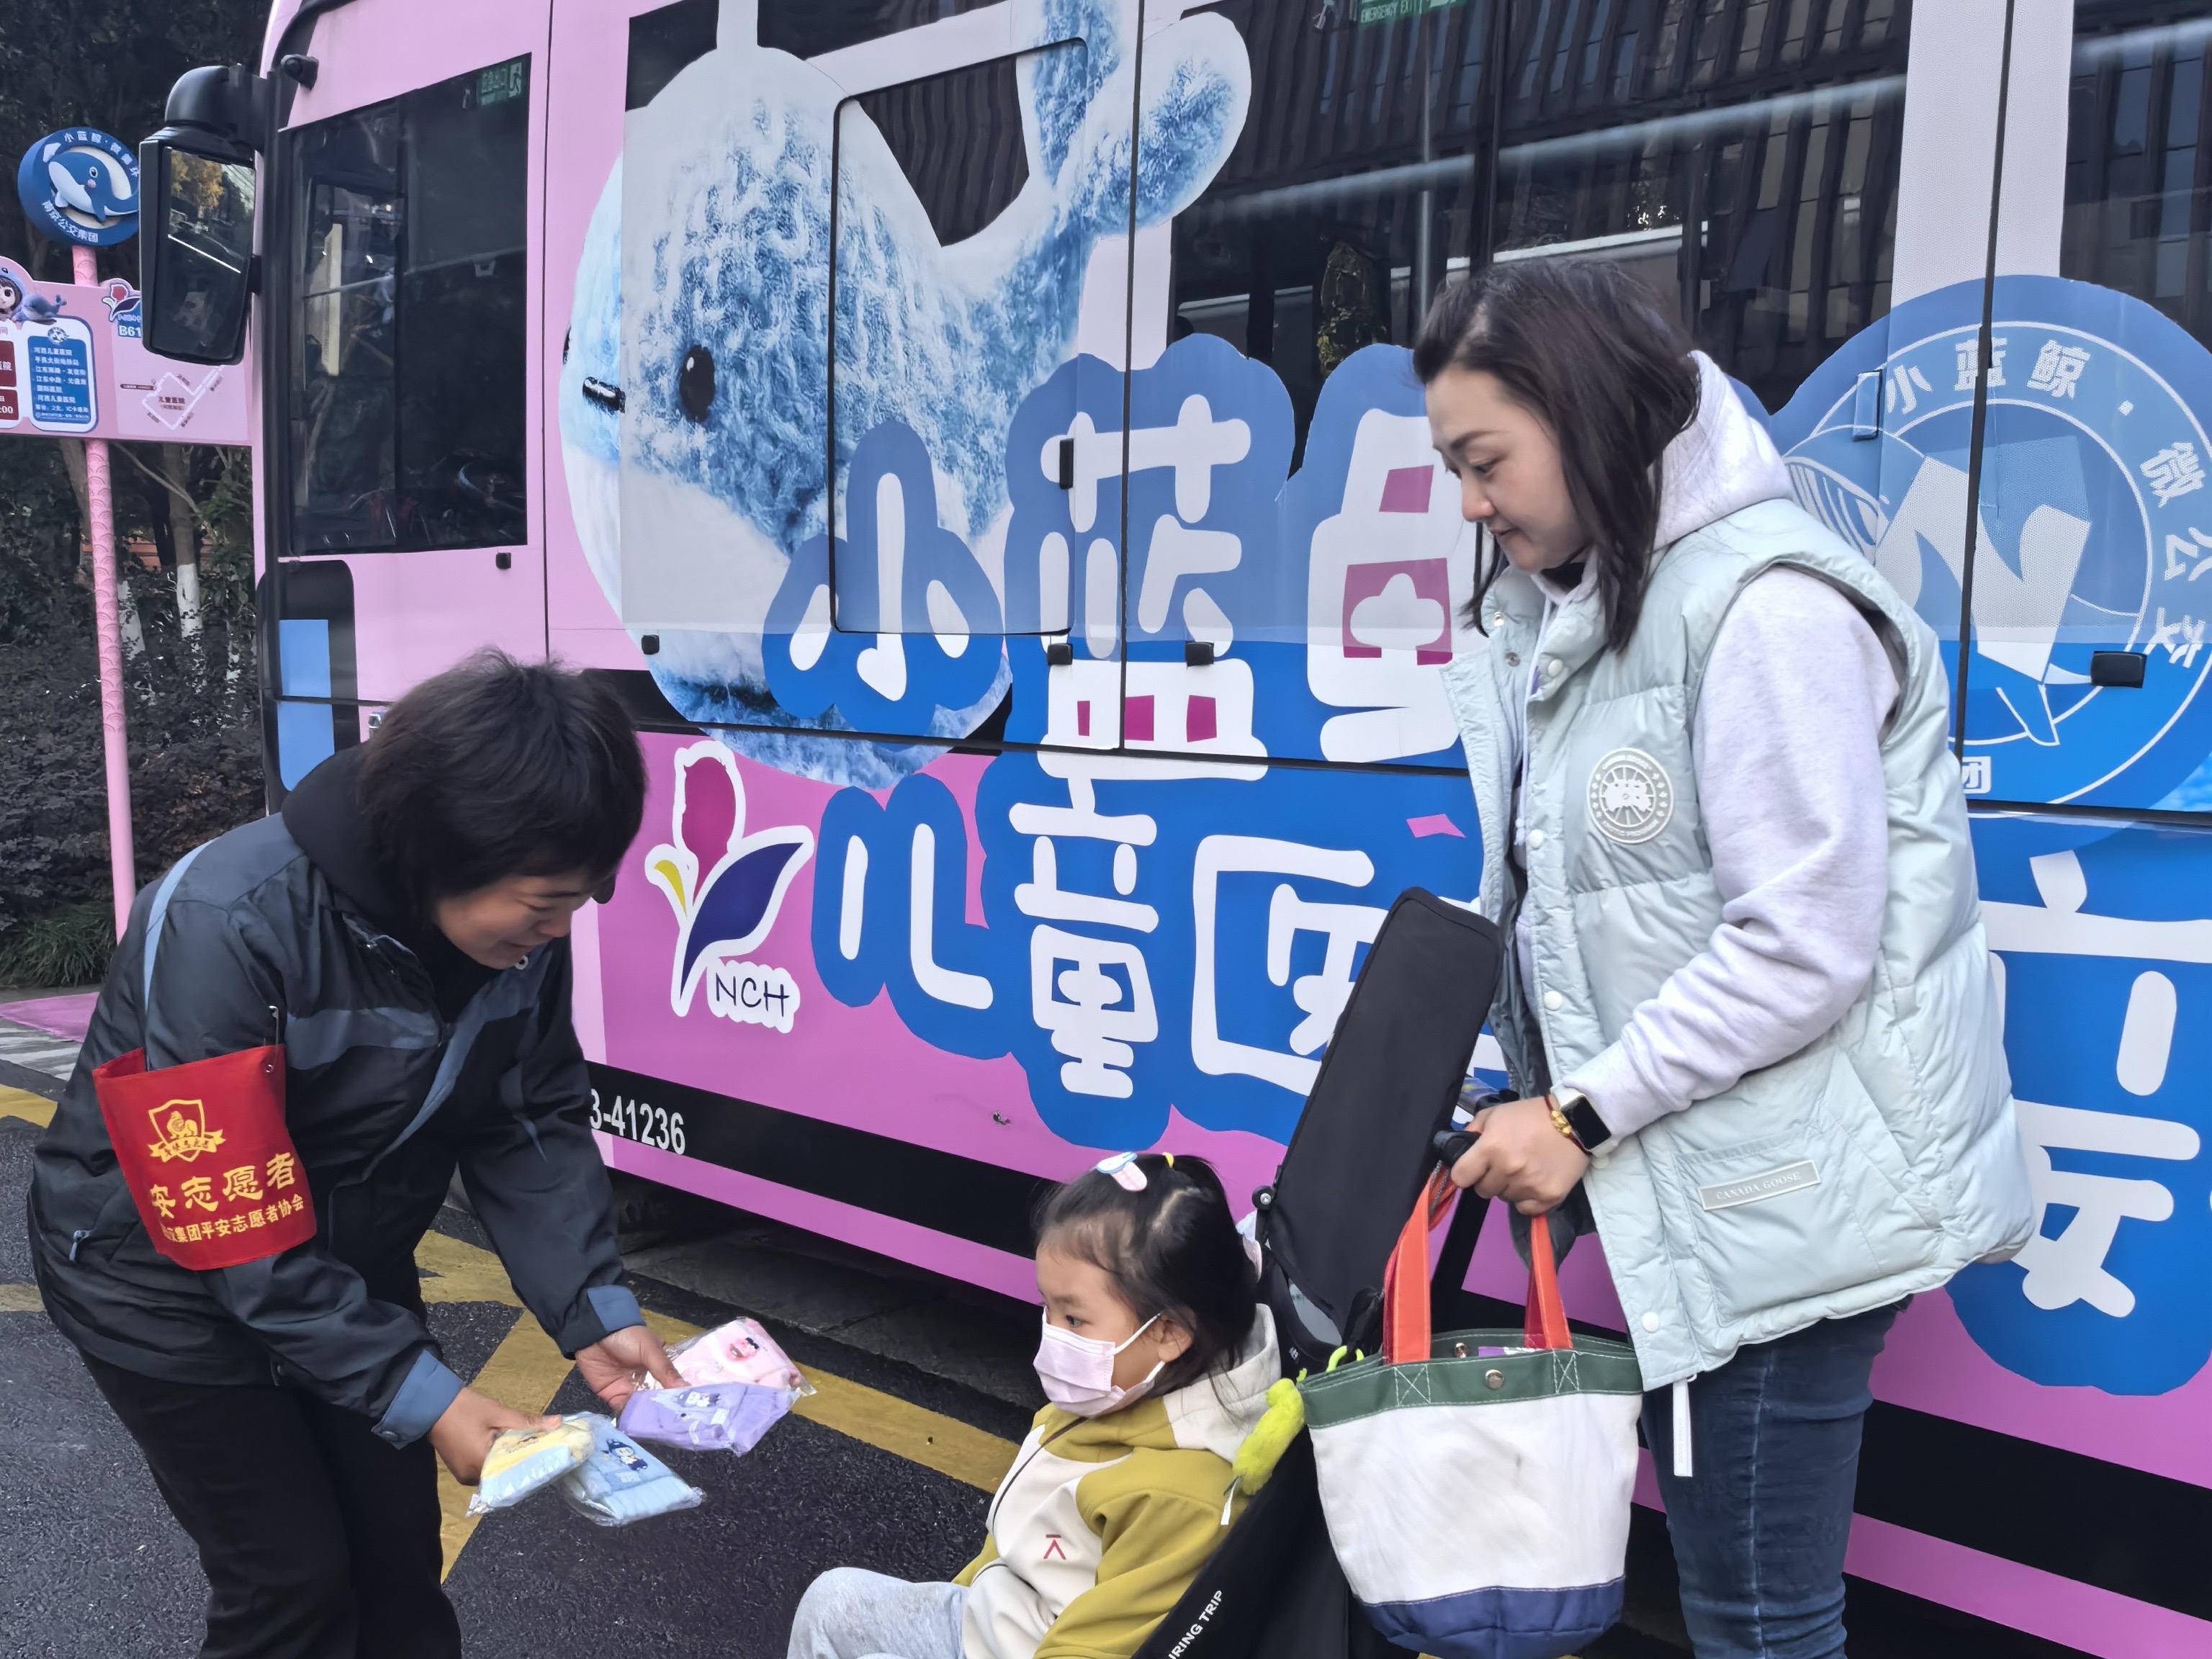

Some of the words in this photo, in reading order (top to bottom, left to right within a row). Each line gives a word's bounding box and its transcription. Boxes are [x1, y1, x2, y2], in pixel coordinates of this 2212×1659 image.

[716, 972, 790, 1017] NCH
[1716, 1183, 1761, 1200] CANADA
[1763, 1171, 1801, 1190] GOOSE
[1198, 1589, 1223, 1622] TRIP
